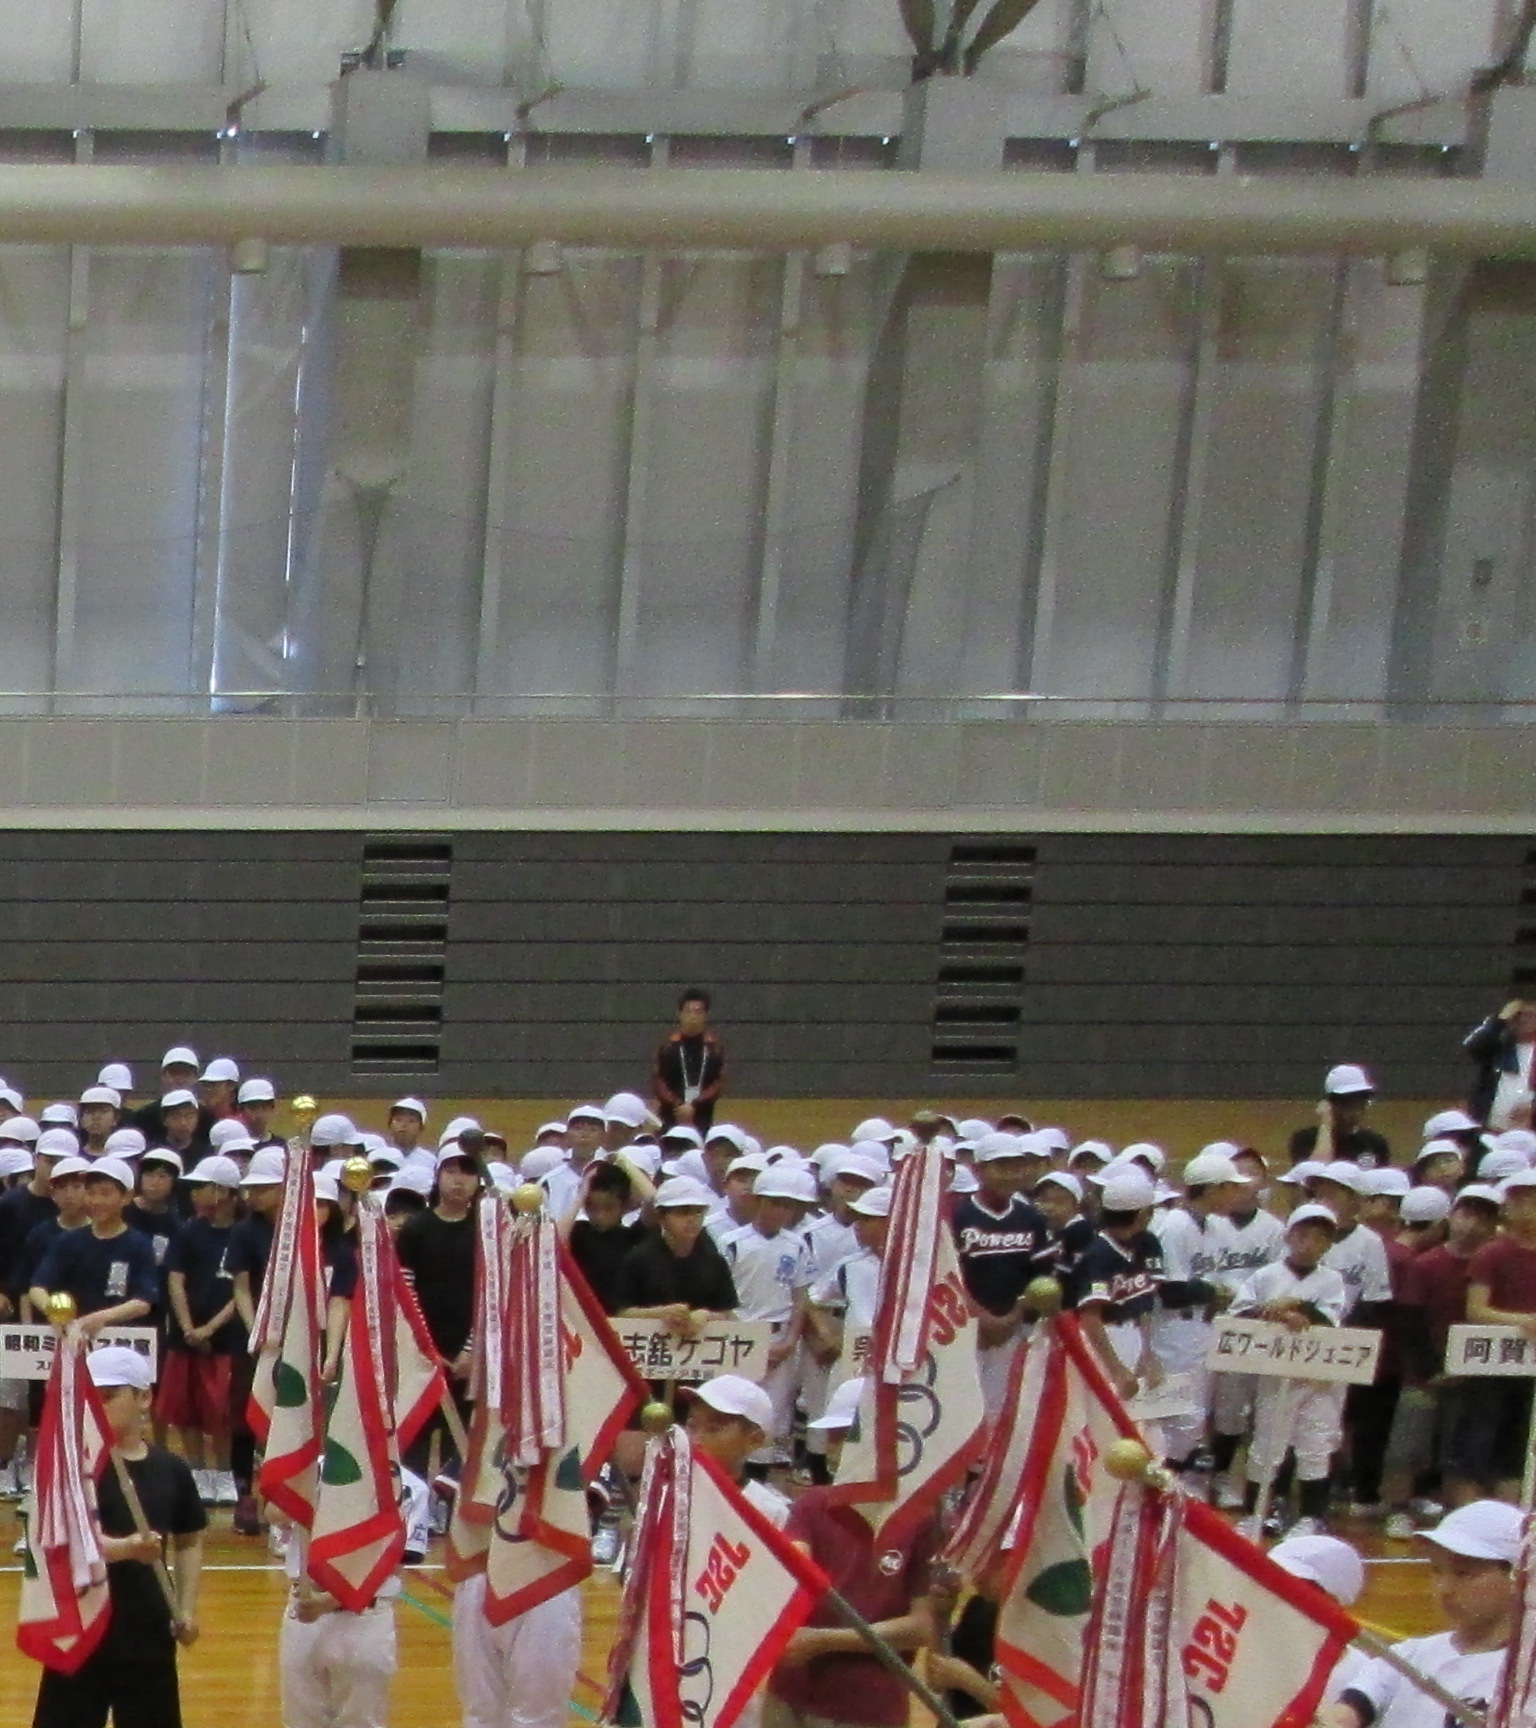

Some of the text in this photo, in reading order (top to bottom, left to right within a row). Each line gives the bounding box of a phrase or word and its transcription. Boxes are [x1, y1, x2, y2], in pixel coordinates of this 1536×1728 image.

[1217, 1330, 1373, 1368] 広ワールドジュニア
